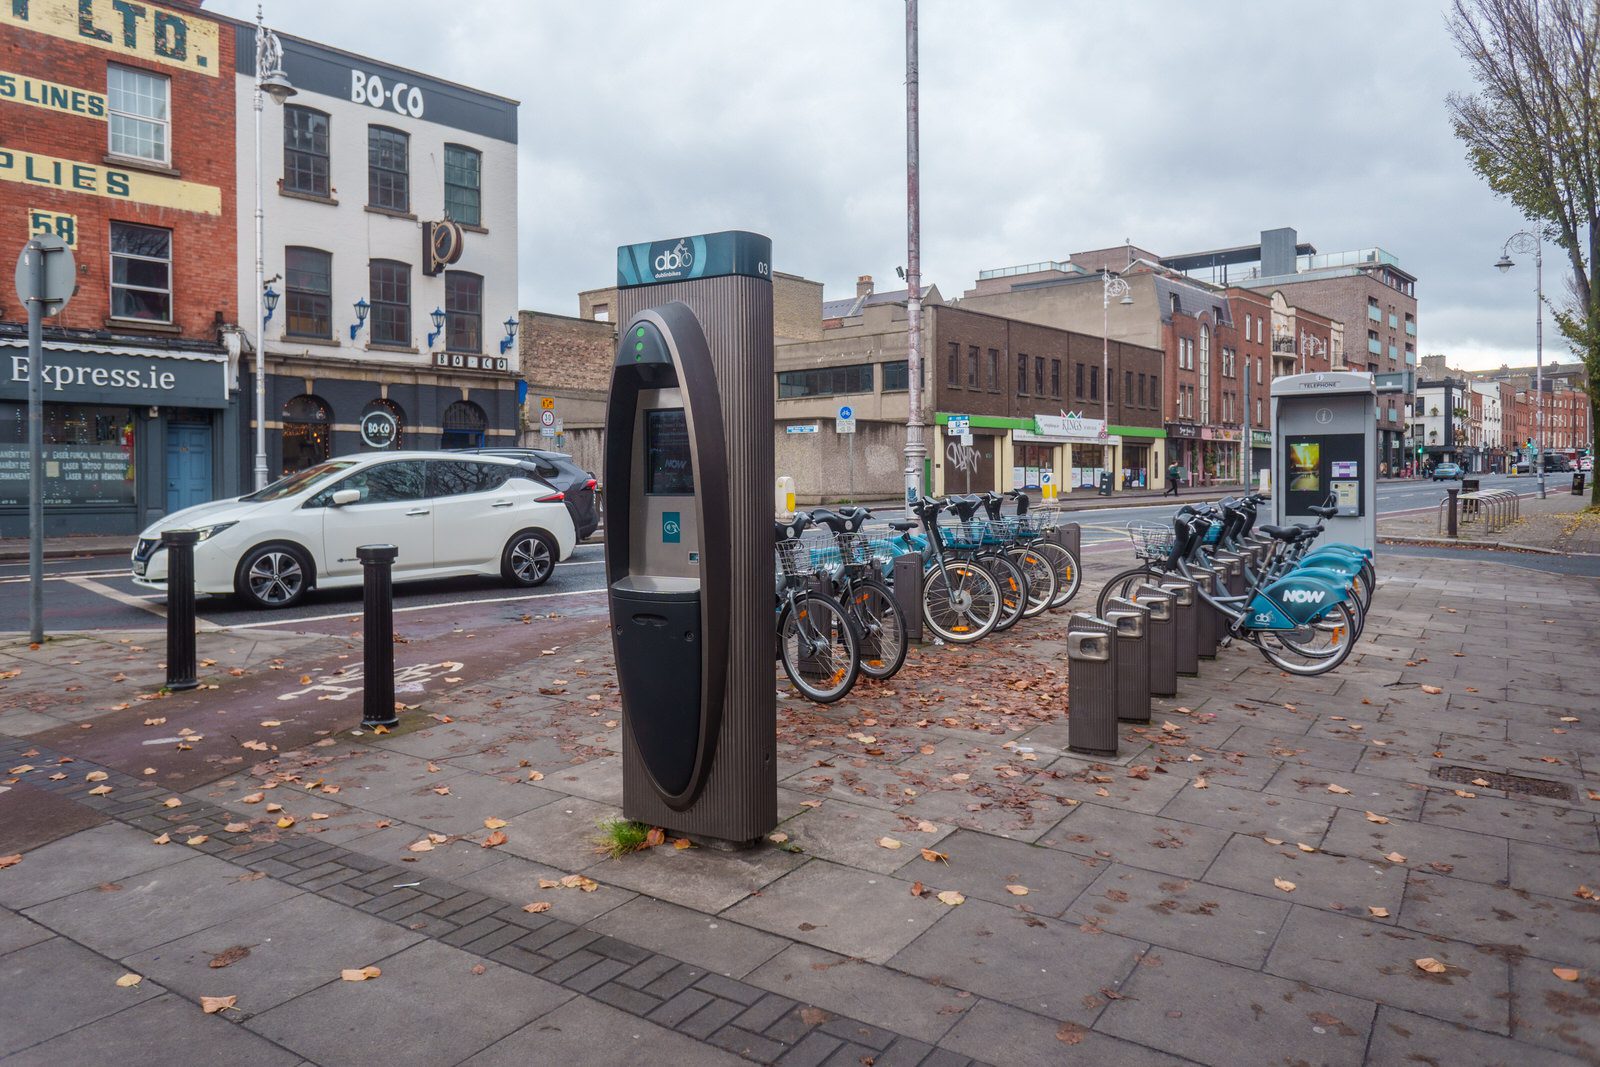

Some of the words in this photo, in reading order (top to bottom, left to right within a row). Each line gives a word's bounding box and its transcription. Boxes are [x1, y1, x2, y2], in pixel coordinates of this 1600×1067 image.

[78, 0, 208, 68] LTD.
[32, 213, 74, 245] 58
[654, 271, 682, 279] dublinbikes
[757, 261, 769, 276] 03
[10, 355, 176, 391] Express.ie
[1303, 381, 1337, 389] TELEPHONE
[1062, 419, 1082, 432] KINGS
[664, 459, 687, 469] NOW
[1282, 589, 1326, 604] NOW
